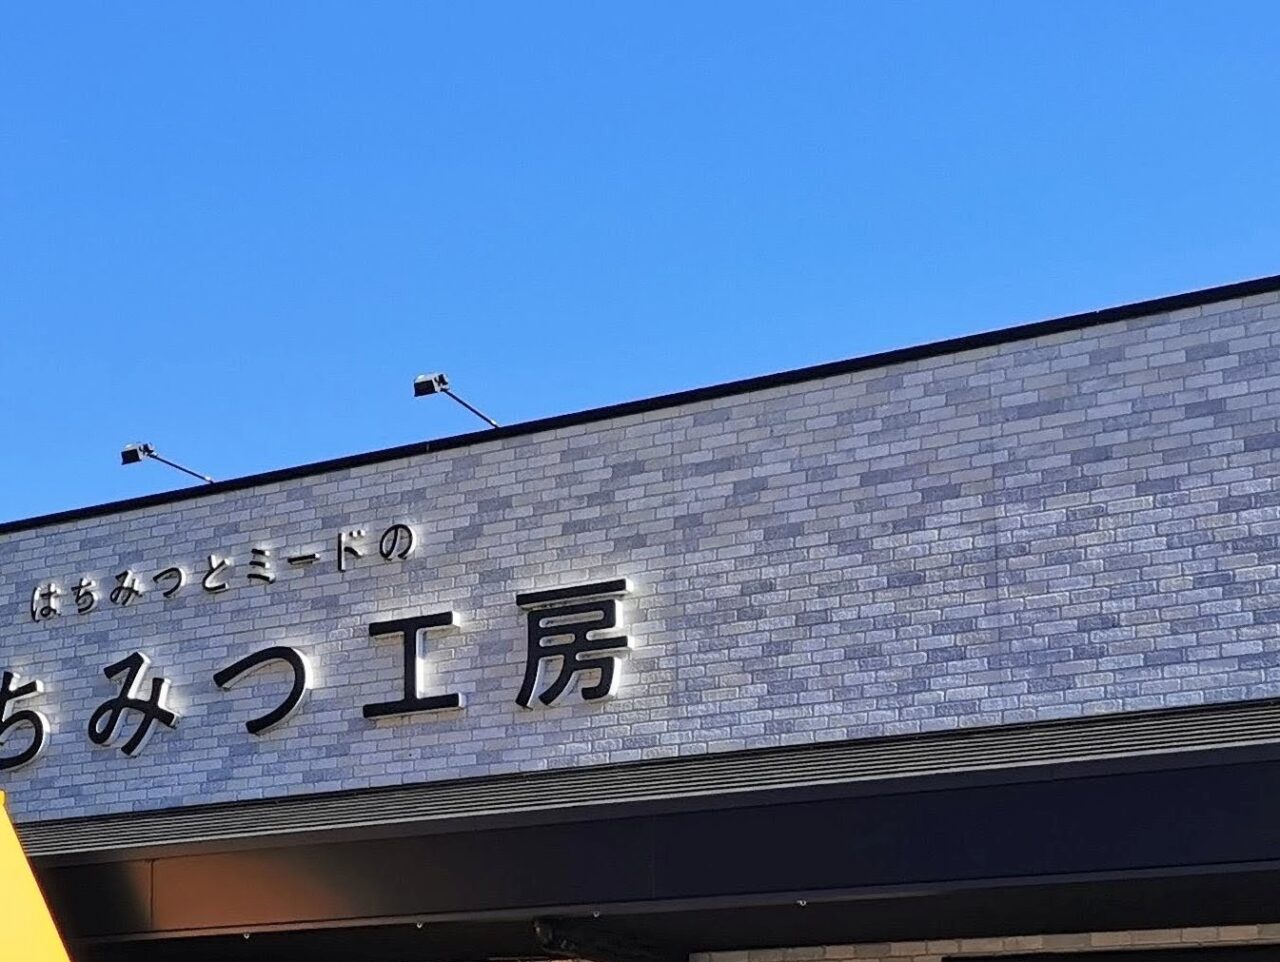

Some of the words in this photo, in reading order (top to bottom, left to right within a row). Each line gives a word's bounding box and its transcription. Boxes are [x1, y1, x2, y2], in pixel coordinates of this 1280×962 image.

[31, 523, 417, 622] はちみつとミードの
